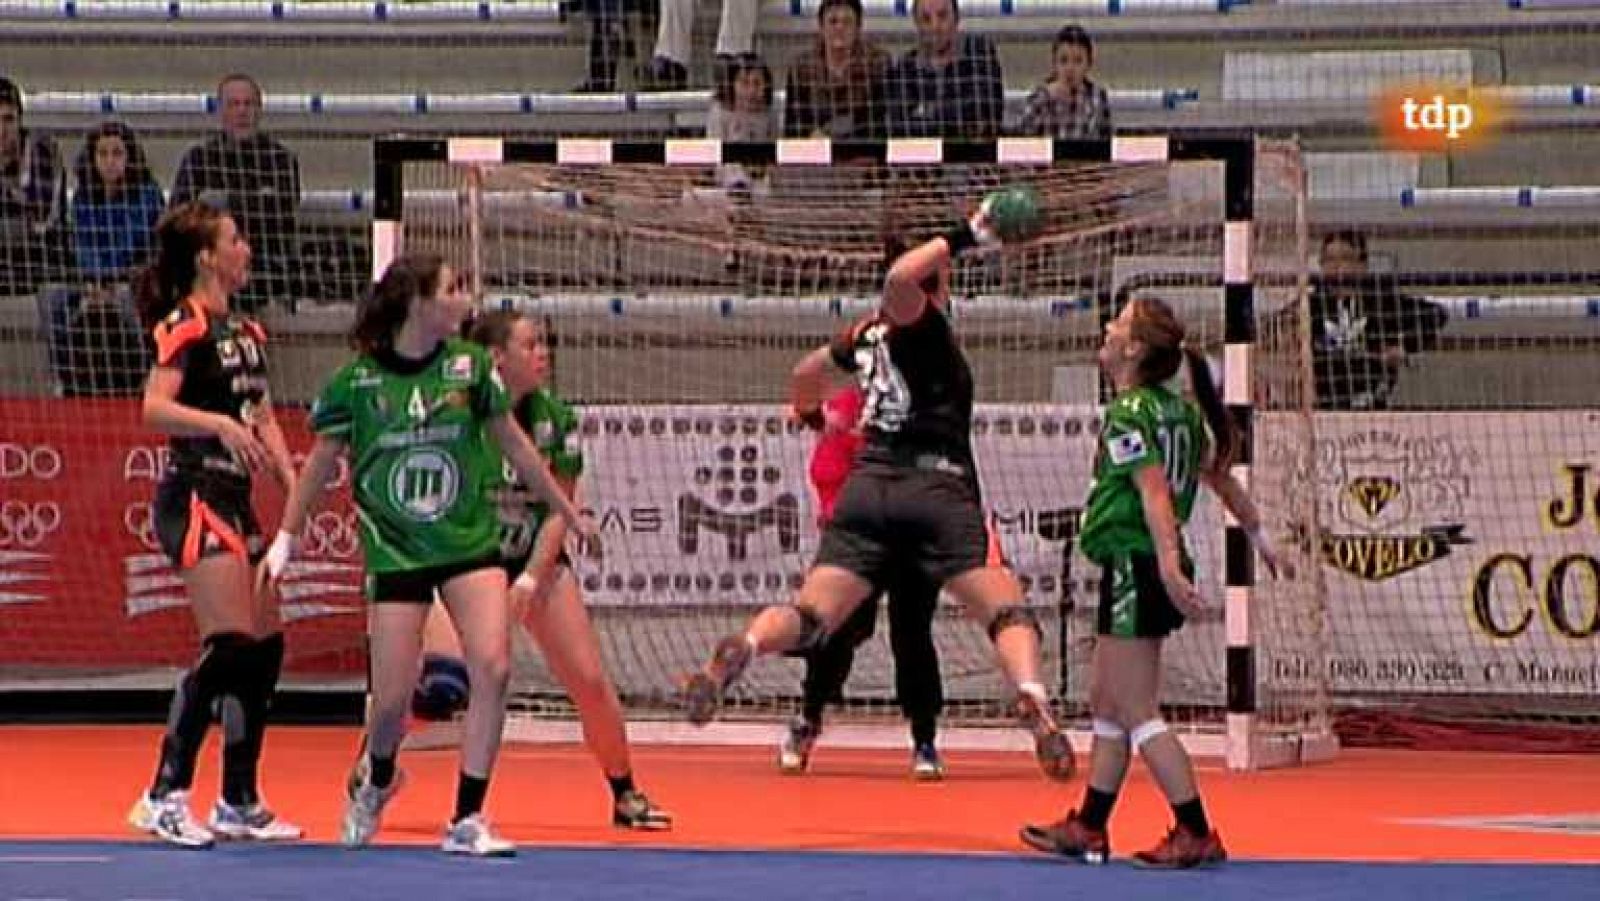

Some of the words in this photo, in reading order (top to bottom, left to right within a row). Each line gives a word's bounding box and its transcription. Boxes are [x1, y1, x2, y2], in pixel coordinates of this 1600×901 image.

[407, 384, 427, 420] 4
[579, 506, 663, 533] AS
[1548, 463, 1600, 528] J
[1472, 553, 1600, 639] CO
